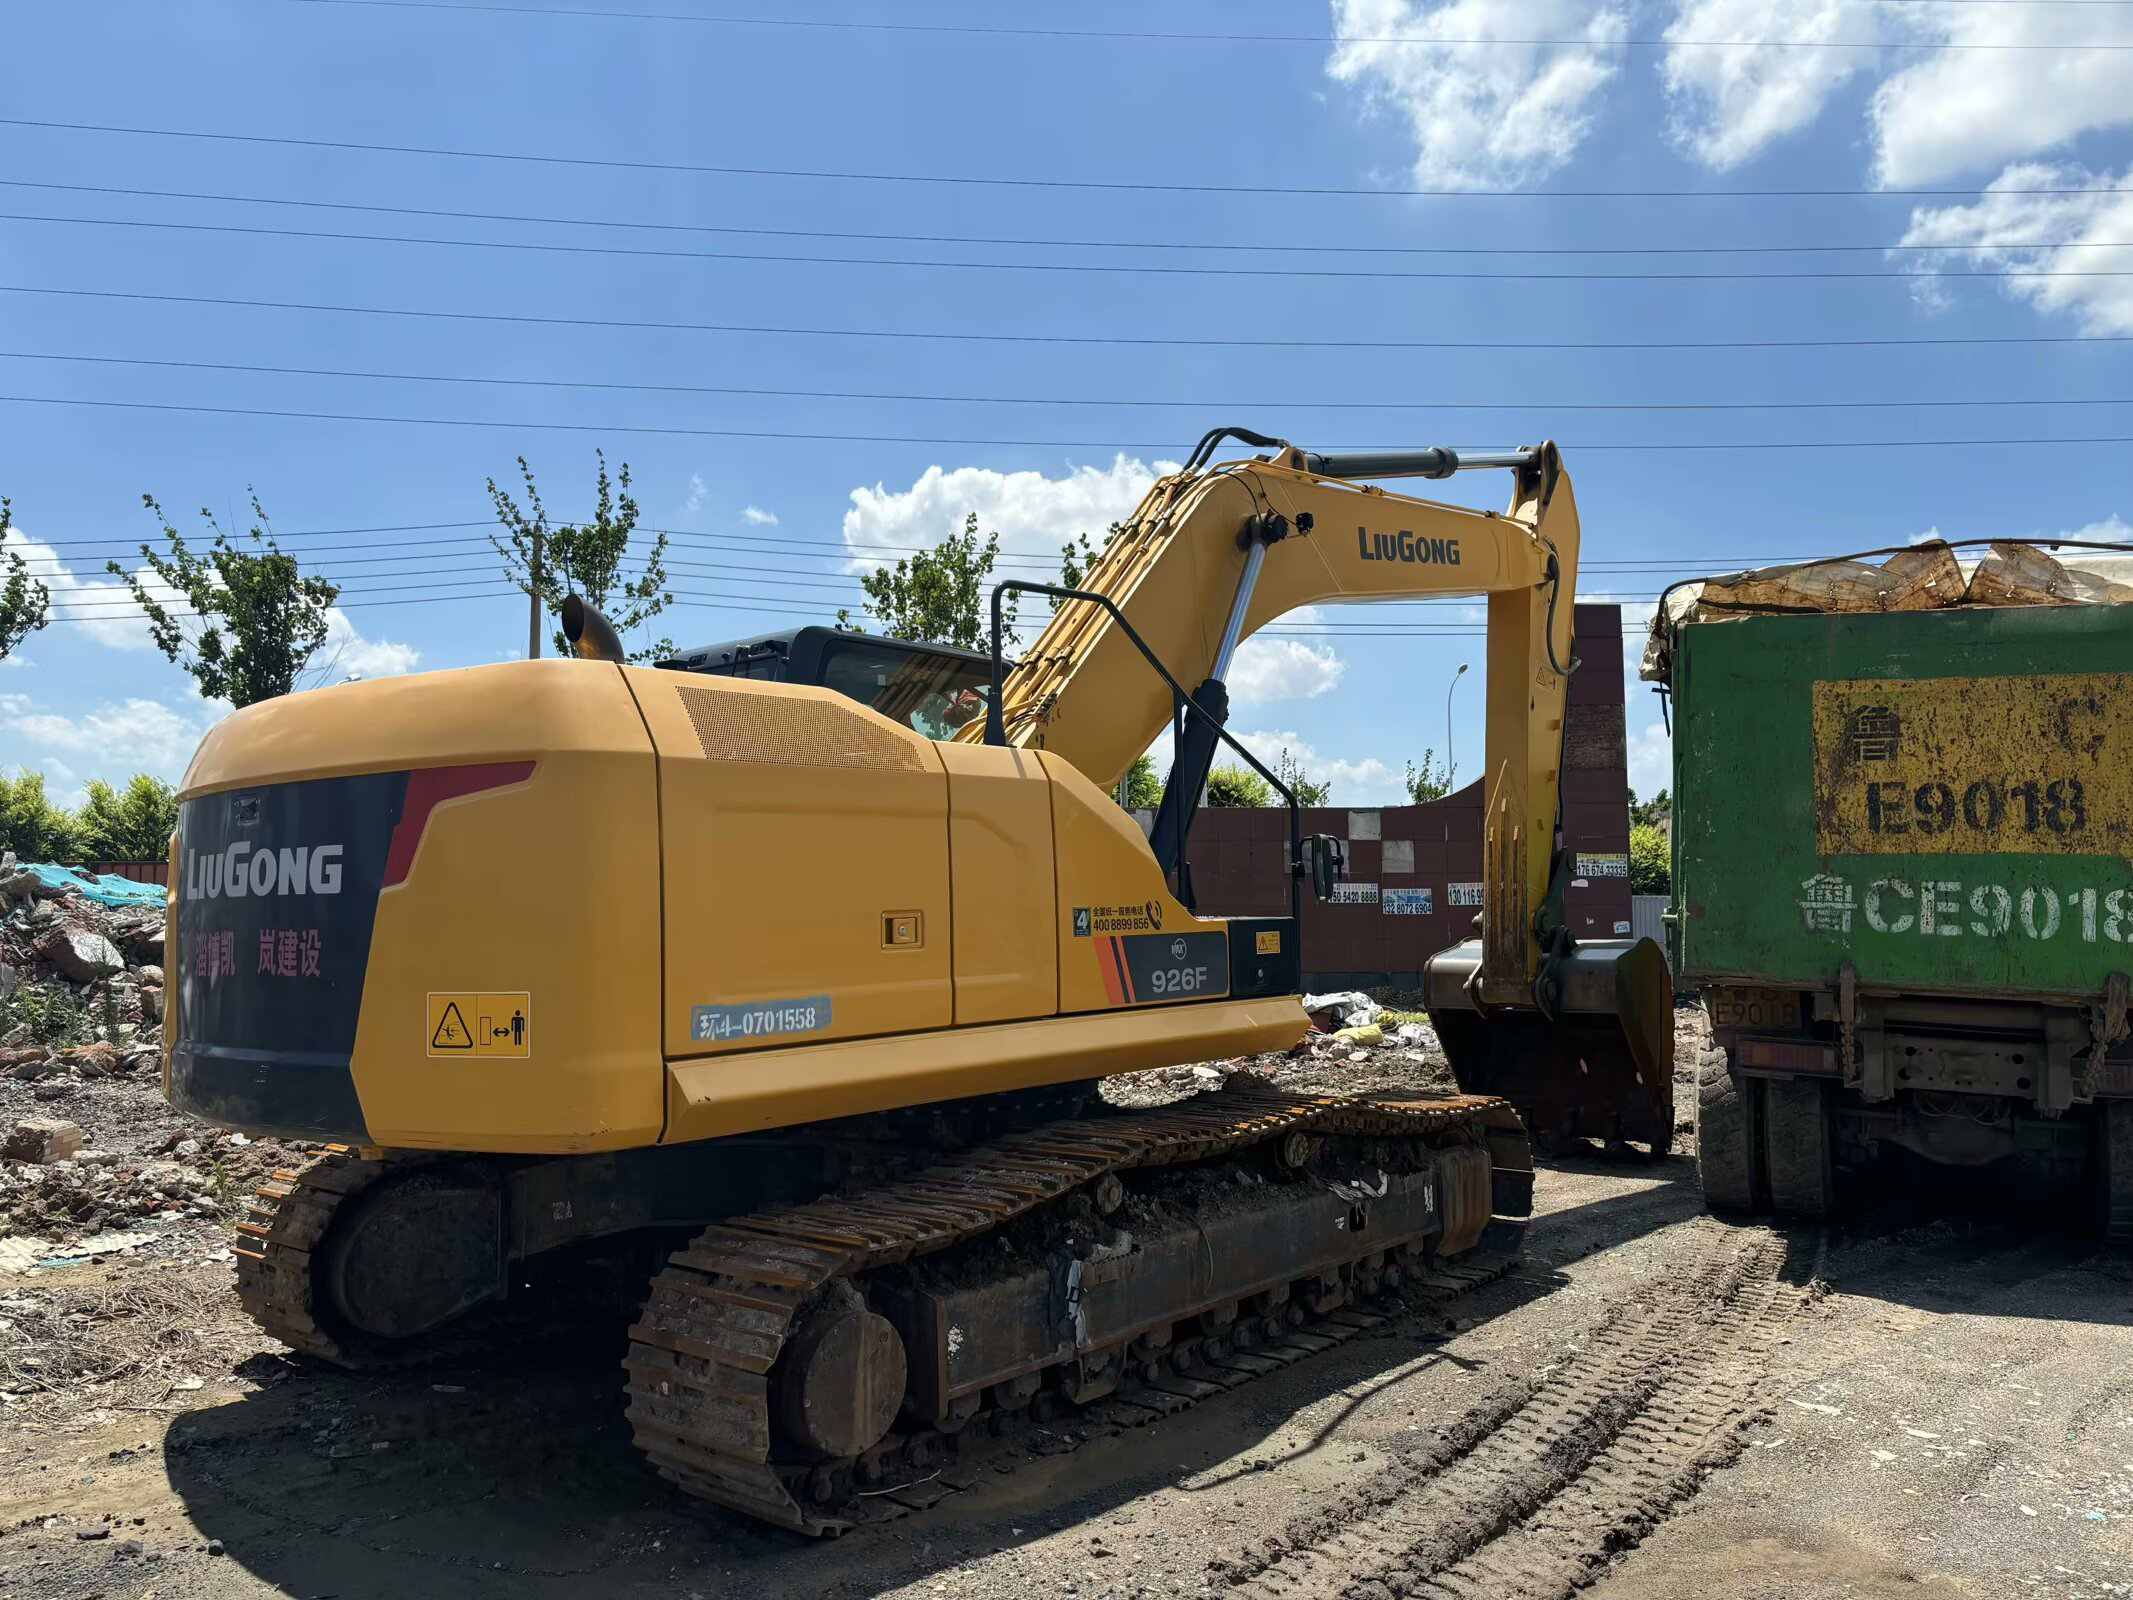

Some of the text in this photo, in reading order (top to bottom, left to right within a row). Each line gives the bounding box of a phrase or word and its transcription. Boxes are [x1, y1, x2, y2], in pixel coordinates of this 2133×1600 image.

[1866, 777, 2088, 836] E9018
[1383, 903, 1432, 914] 132 8072 6904
[1094, 919, 1110, 931] 400
[1111, 918, 1133, 930] 8899
[257, 927, 321, 976] 岚建设
[1152, 966, 1208, 994] 926F
